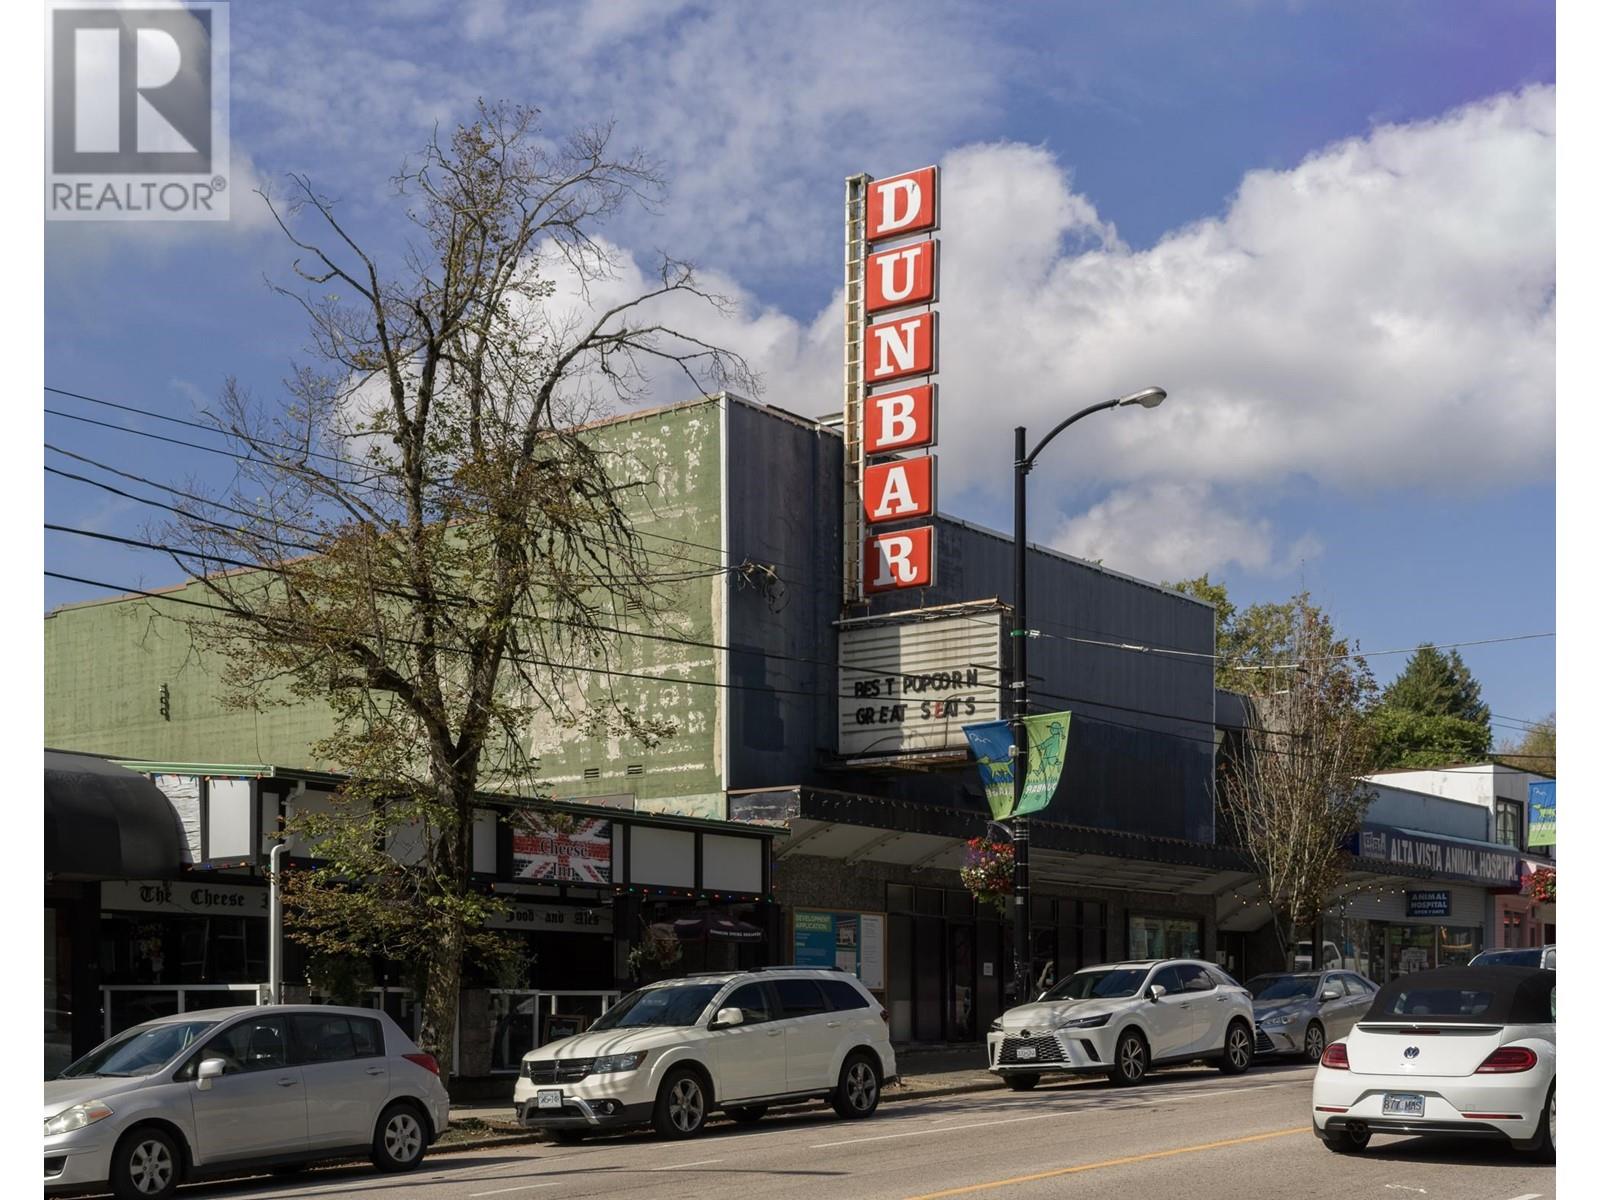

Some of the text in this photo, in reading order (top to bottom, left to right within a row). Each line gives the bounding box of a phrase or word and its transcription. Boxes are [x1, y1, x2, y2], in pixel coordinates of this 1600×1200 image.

[872, 178, 922, 587] DUNBAR
[854, 669, 978, 698] BEST POPCORN
[856, 697, 975, 725] GREAT SEATS
[541, 838, 589, 859] Cheese
[553, 863, 576, 878] Inn
[1391, 838, 1414, 865] ALTA
[1415, 841, 1443, 871] VISTA
[1444, 847, 1479, 876] ANIMAL
[1479, 851, 1519, 882] HOSPITAL
[139, 886, 172, 905] The
[191, 888, 245, 908] Cheese
[1411, 892, 1447, 900] ANIMAL
[1411, 901, 1448, 909] HOSPITAL
[545, 910, 565, 923] and
